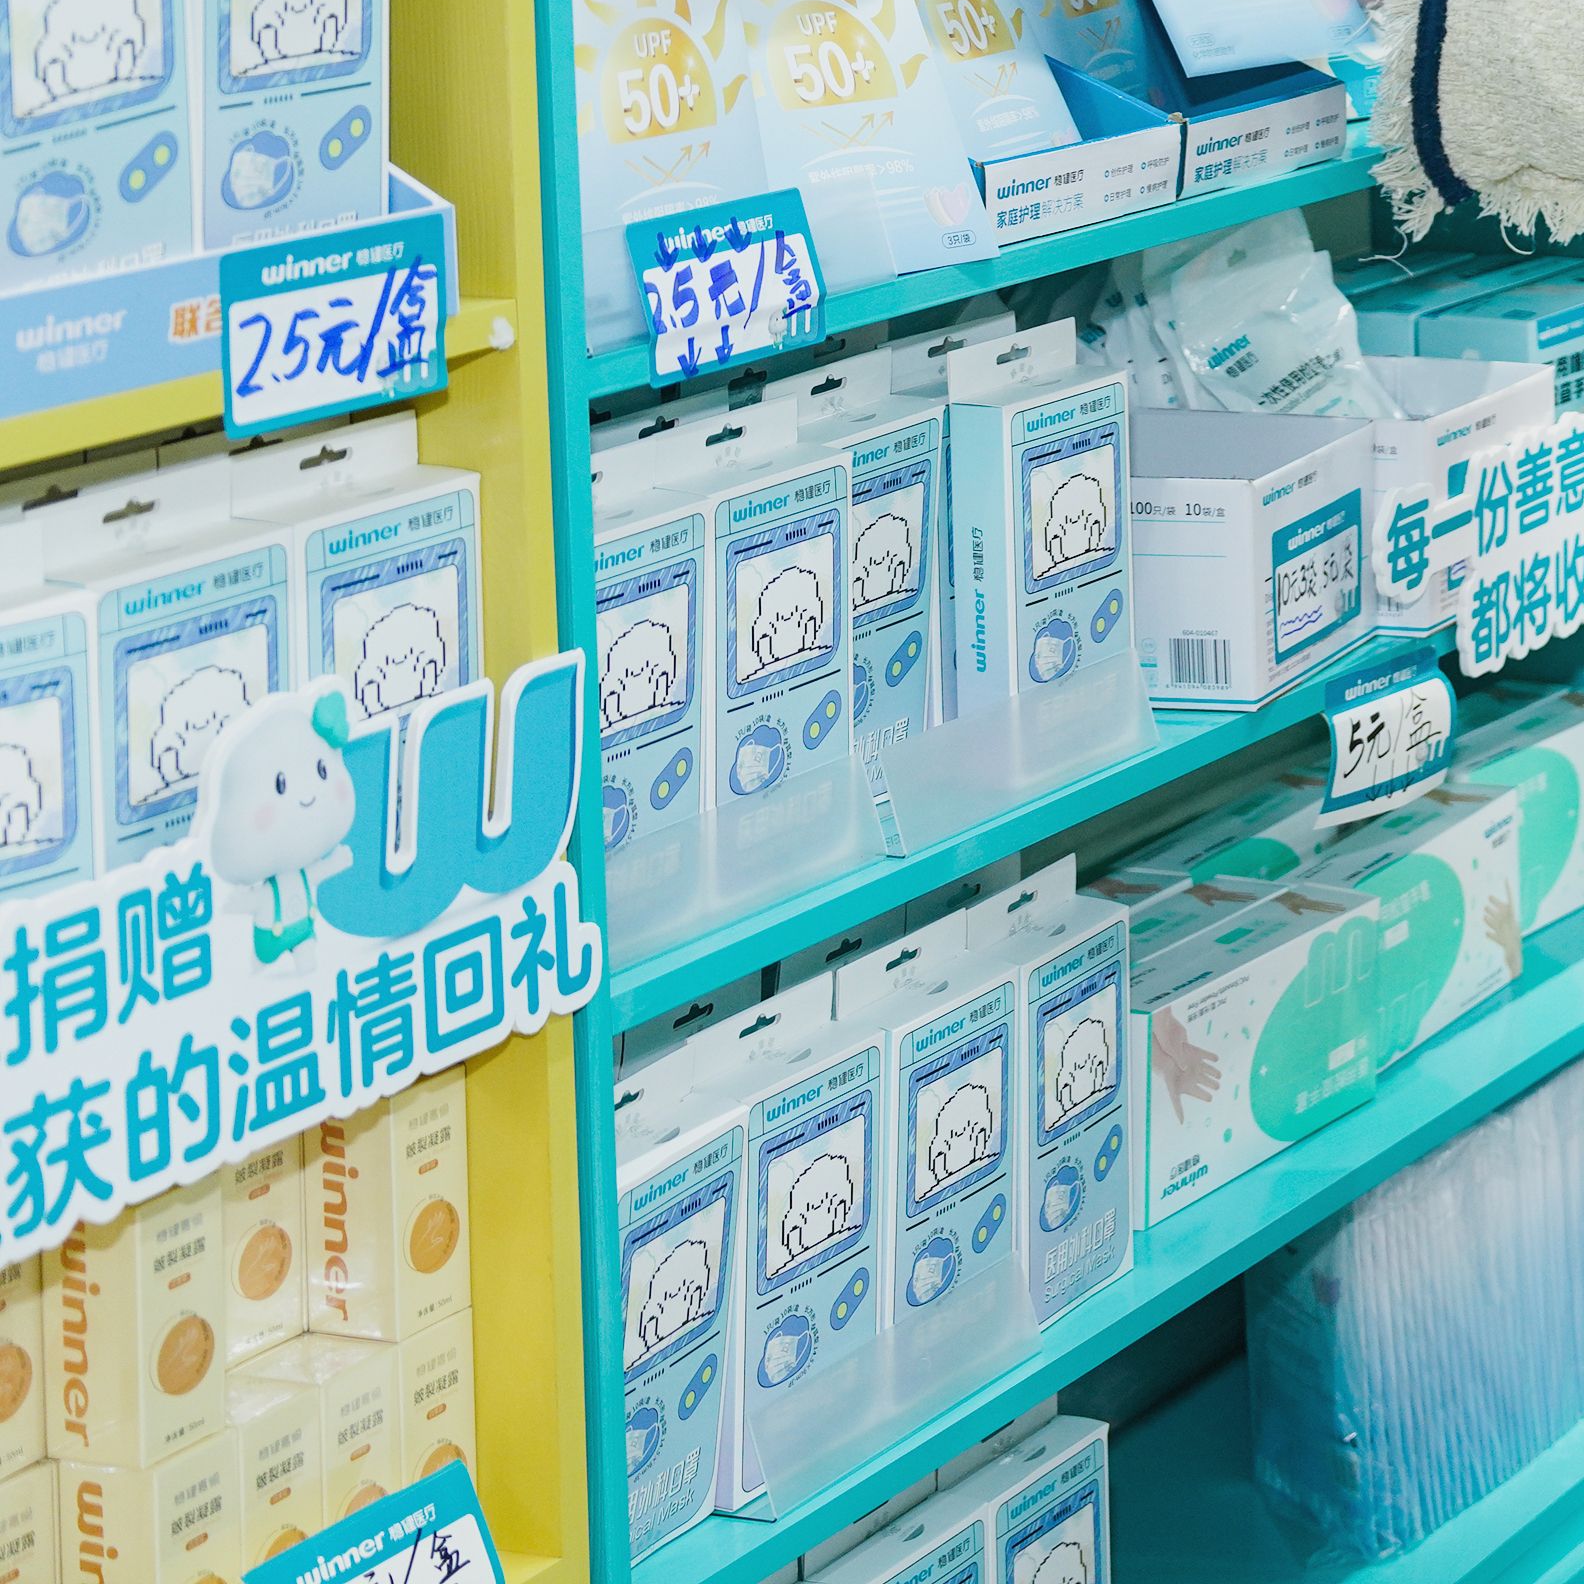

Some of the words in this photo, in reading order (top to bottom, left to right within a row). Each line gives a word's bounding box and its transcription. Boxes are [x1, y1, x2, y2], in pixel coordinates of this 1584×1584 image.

[798, 10, 838, 36] UPF
[634, 29, 673, 58] UPF
[783, 40, 875, 104] 50+
[616, 62, 701, 136] 50+
[1197, 133, 1245, 157] winner
[997, 175, 1052, 201] winner
[1053, 168, 1085, 186] 稳健医疗
[1194, 149, 1268, 184] 家庭护理解决方案
[996, 192, 1085, 230] 家庭护理解决方案
[261, 250, 352, 287] winner
[16, 308, 128, 353] winner
[236, 254, 439, 398] 2.5元/盒
[1026, 406, 1076, 434] winner
[732, 493, 791, 524] winner
[794, 479, 832, 504] 稳健医疗
[1185, 502, 1226, 518] 10袋/盒
[1262, 480, 1296, 507] winner
[329, 519, 403, 557] winner
[649, 527, 689, 554] 稳健医疗
[1287, 519, 1326, 552] winner
[125, 580, 207, 617] winner
[971, 588, 988, 674] winner
[1344, 672, 1392, 702] winner
[3, 863, 214, 1066] 捐赠
[1040, 954, 1085, 989] winner
[3, 883, 594, 1219] 获的温情回礼
[915, 1016, 967, 1054] winner
[765, 1083, 825, 1124] winner
[827, 1061, 865, 1092] 稳健医疗
[632, 1166, 690, 1213] winner
[691, 1142, 729, 1176] 稳健医疗
[1160, 1164, 1209, 1200] winner
[1043, 1207, 1118, 1284] 医用外科口罩
[1086, 1244, 1117, 1276] Mask
[659, 1489, 697, 1528] Mask
[1010, 1478, 1058, 1521] winner
